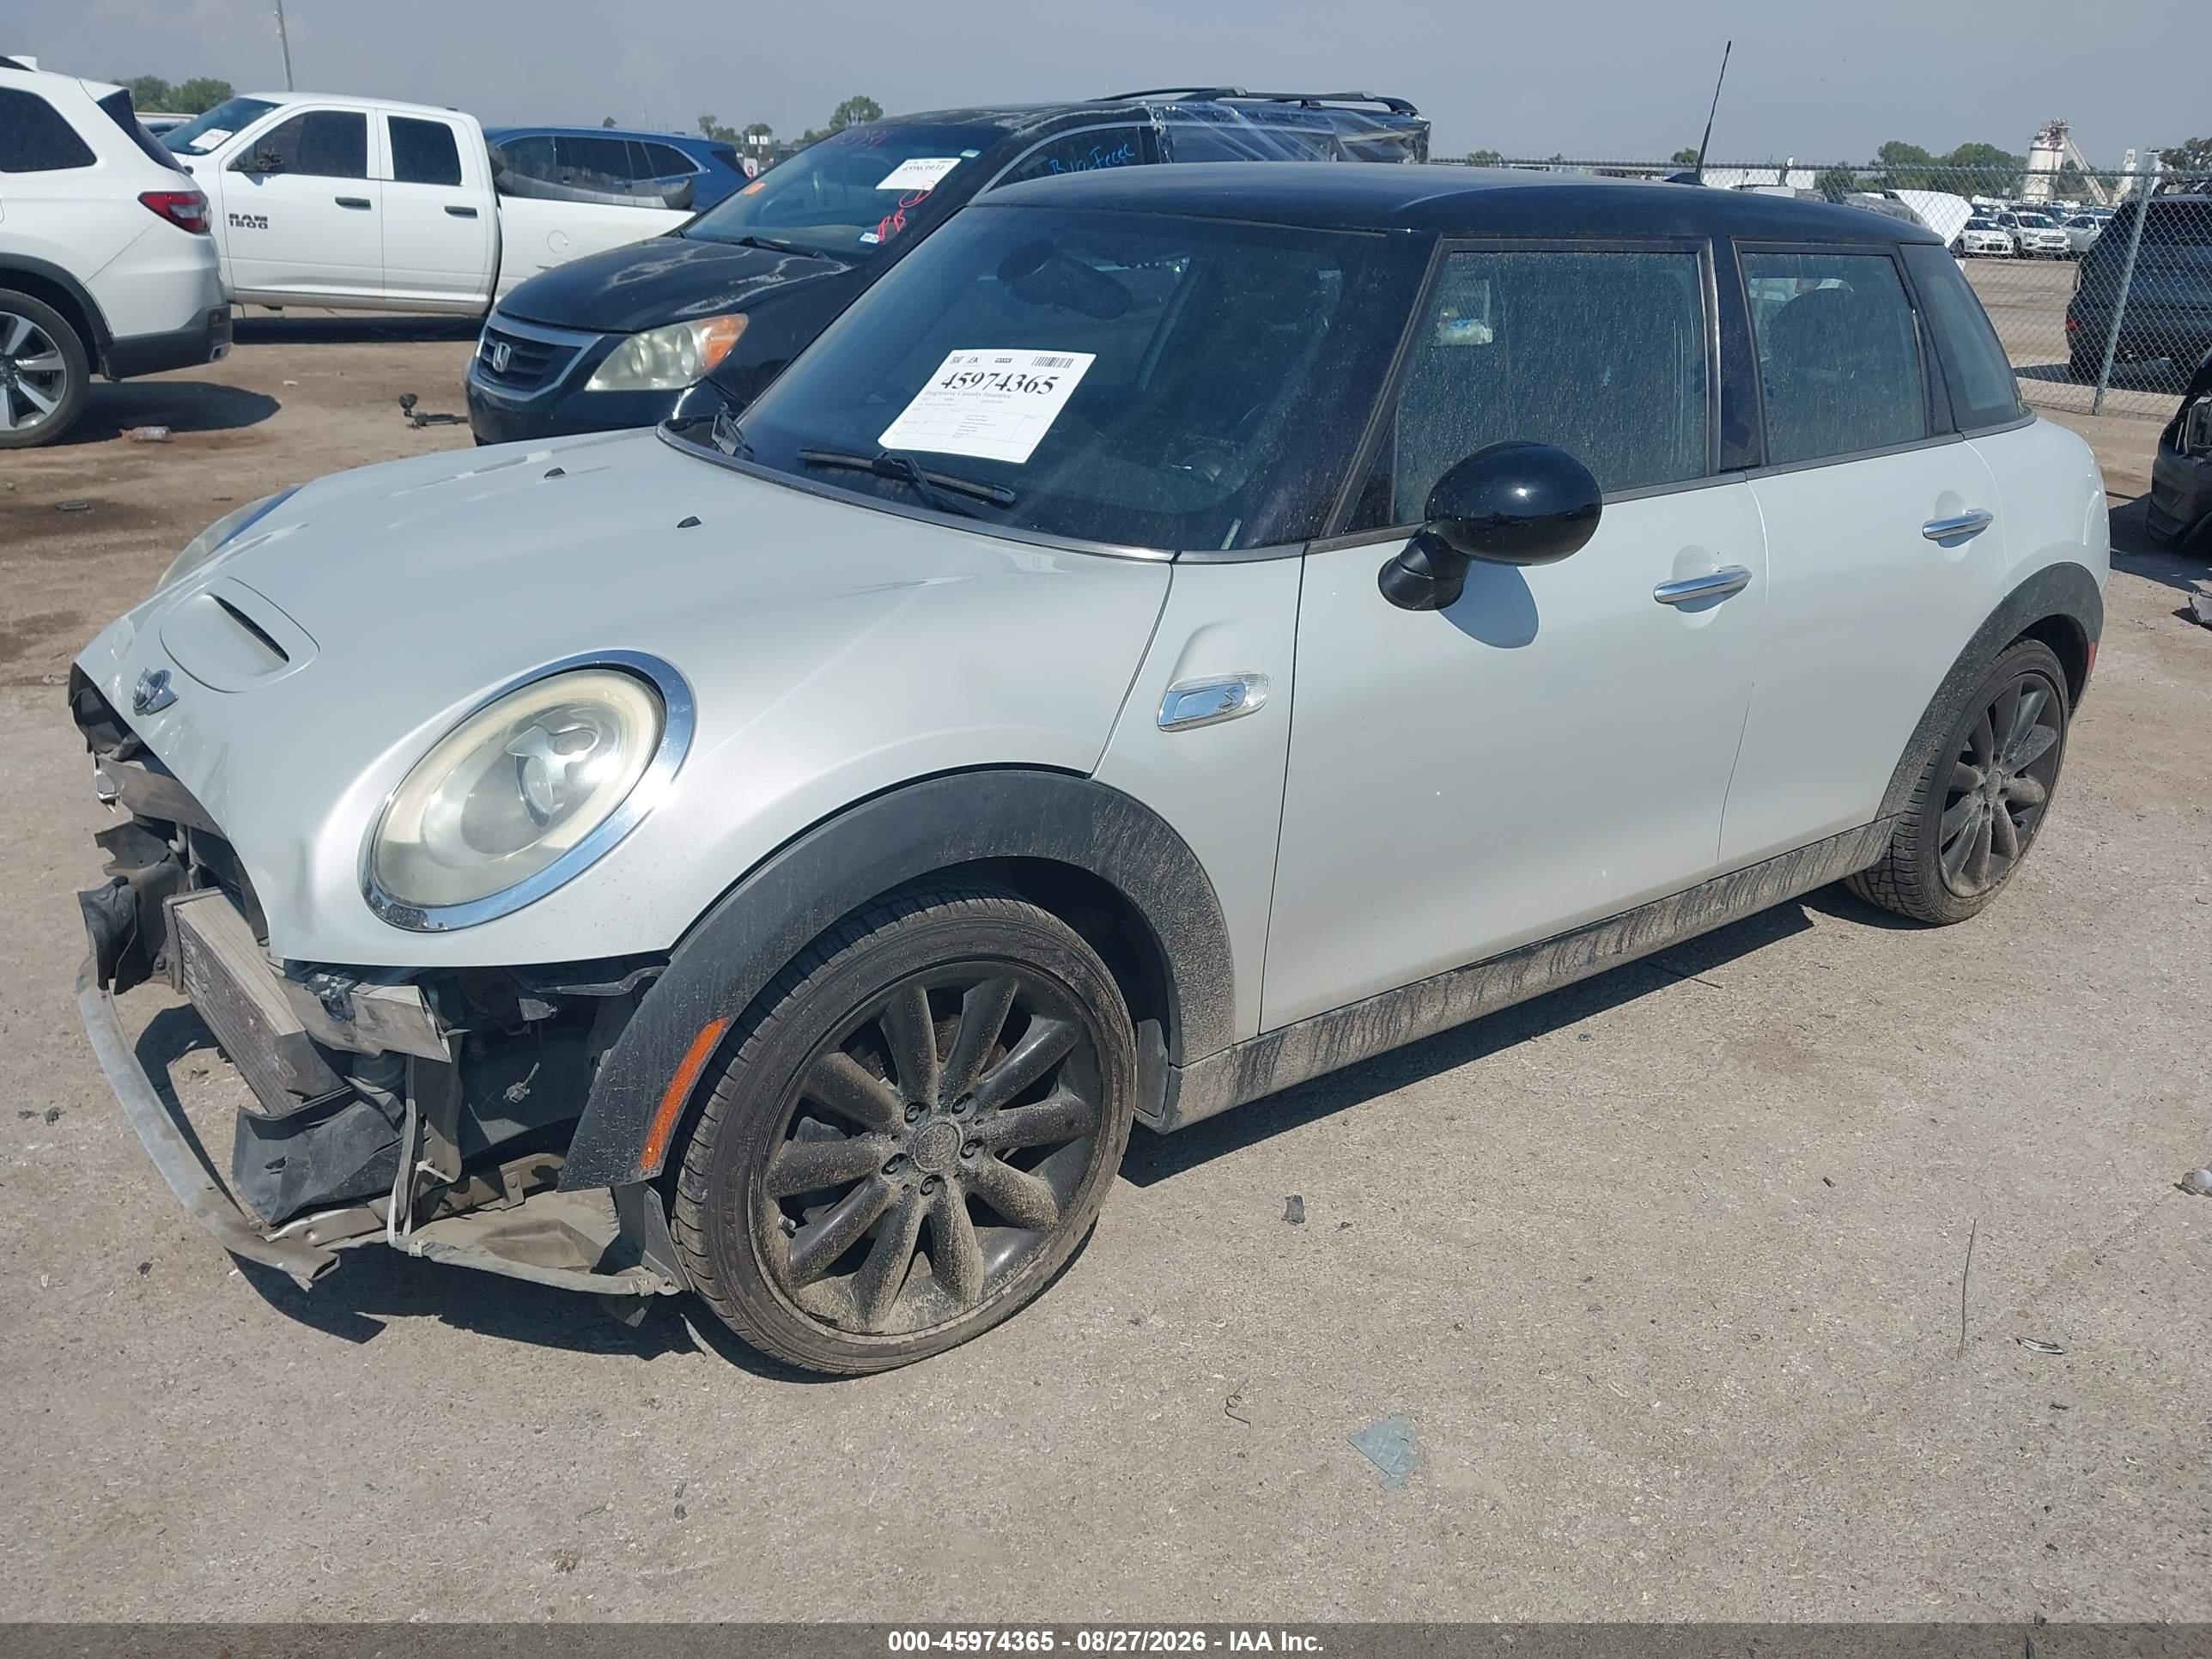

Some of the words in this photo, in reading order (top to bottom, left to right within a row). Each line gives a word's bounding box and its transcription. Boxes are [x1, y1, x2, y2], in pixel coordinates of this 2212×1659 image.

[228, 212, 268, 223] RAM
[229, 219, 269, 229] 1500
[940, 371, 1061, 395] 45974365
